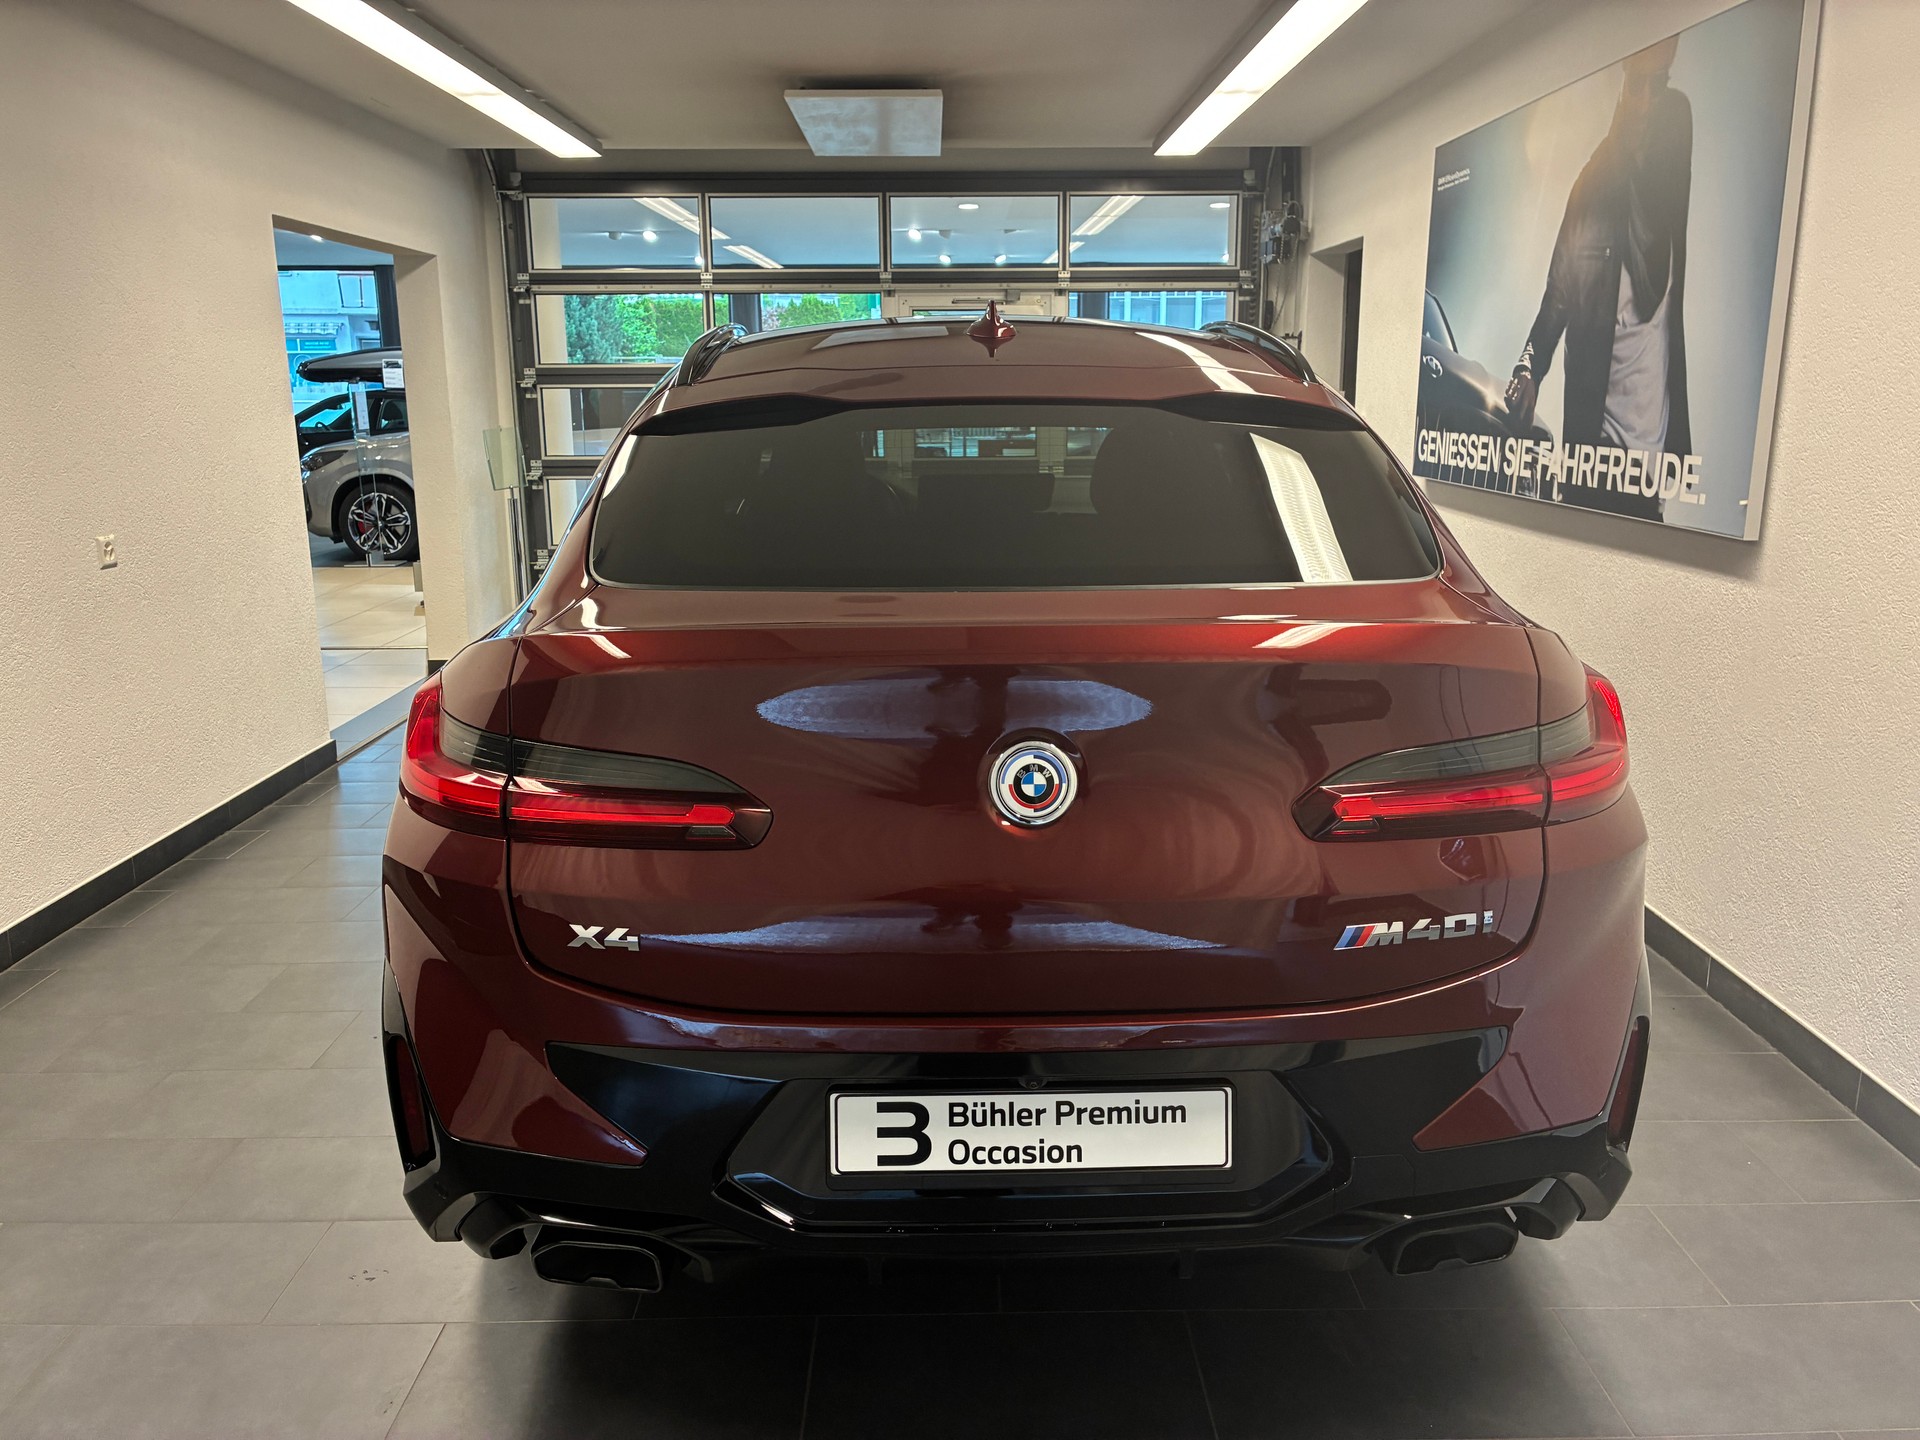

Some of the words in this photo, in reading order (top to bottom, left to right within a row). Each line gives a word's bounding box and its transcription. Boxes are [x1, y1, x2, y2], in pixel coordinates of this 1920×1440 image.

[1417, 429, 1500, 473] GENIESSEN
[1503, 437, 1533, 478] SIE
[1538, 441, 1705, 504] FAHRFREUDE.
[1016, 764, 1052, 778] BMW
[567, 924, 640, 951] X4
[948, 1101, 1046, 1127] Bühler
[1056, 1099, 1187, 1125] Premium
[948, 1138, 1083, 1164] Occasion
